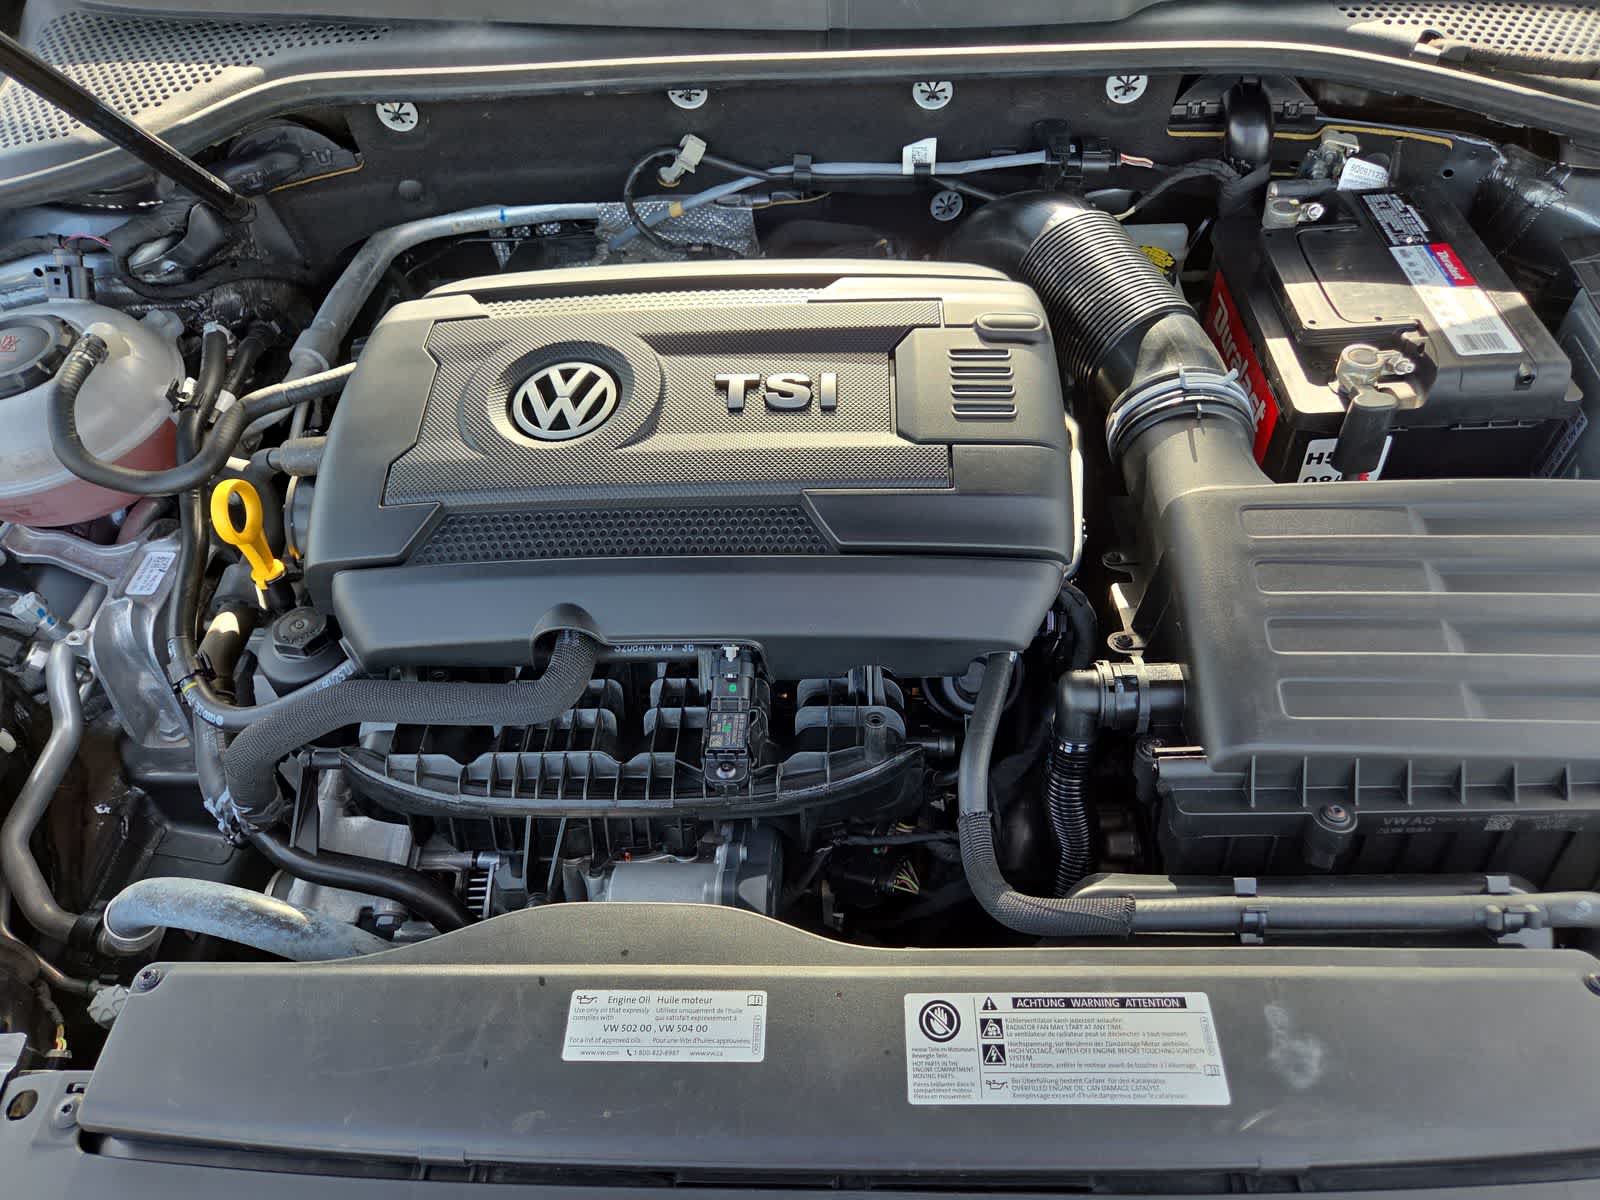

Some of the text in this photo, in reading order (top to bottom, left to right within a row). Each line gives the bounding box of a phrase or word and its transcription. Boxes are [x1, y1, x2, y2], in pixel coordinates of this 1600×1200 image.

[715, 373, 838, 411] TSI
[607, 995, 650, 1006] Engine Oil
[656, 995, 713, 1004] Huile moteur
[1016, 998, 1180, 1008] ACHTUNG WARNING ATTENTION
[603, 1024, 619, 1033] VW
[621, 1024, 638, 1033] 502
[640, 1024, 652, 1033] 00
[659, 1024, 675, 1033] VW
[677, 1024, 694, 1033] 504
[695, 1024, 708, 1033] 00
